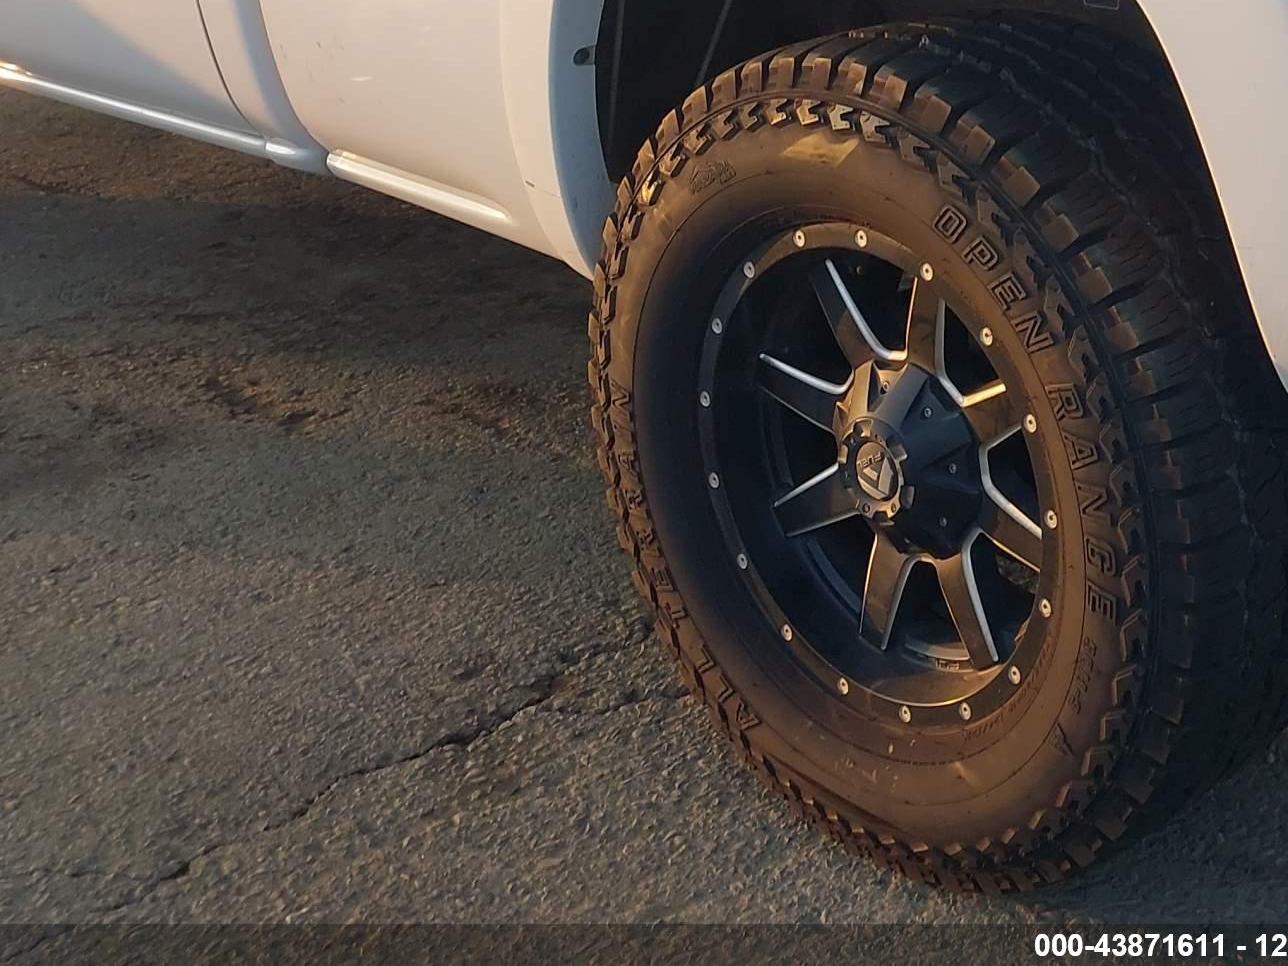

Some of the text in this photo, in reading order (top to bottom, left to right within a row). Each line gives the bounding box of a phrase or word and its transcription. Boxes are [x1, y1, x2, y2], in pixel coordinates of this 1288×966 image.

[931, 203, 1118, 626] OPEN RANGE
[697, 644, 763, 732] ALL
